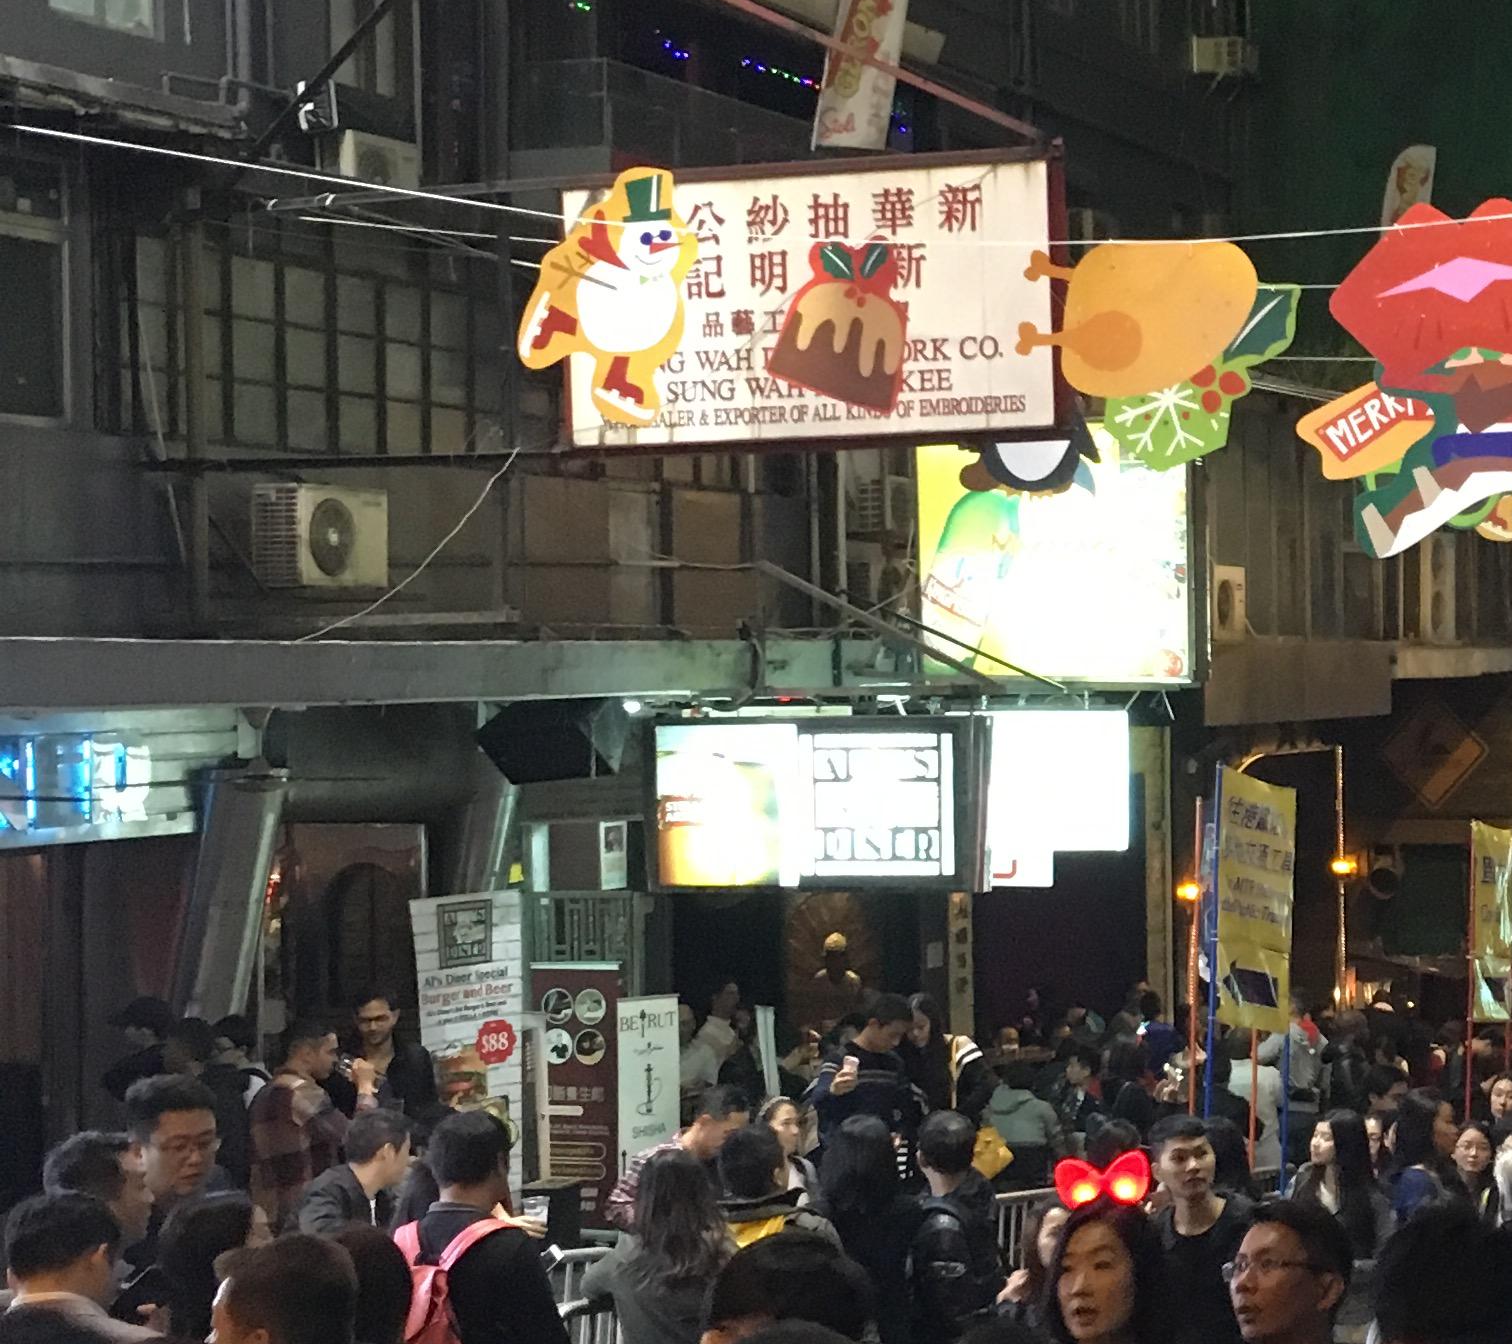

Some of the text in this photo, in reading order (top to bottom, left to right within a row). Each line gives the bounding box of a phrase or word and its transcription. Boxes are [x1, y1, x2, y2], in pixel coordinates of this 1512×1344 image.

[695, 347, 754, 372] WAH
[959, 335, 1004, 360] CO.
[667, 378, 736, 403] SUNG
[902, 368, 953, 393] KEE
[699, 408, 709, 427] &
[714, 404, 787, 427] EXPORTER
[790, 405, 809, 423] OF
[812, 403, 841, 422] ALL
[846, 402, 892, 421] KIN
[896, 400, 914, 418] OF
[919, 394, 1026, 417] EMBROIDERIES
[421, 982, 514, 1007] Burger and Beer
[619, 1009, 676, 1038] BEIRUT
[480, 1030, 509, 1054] $88
